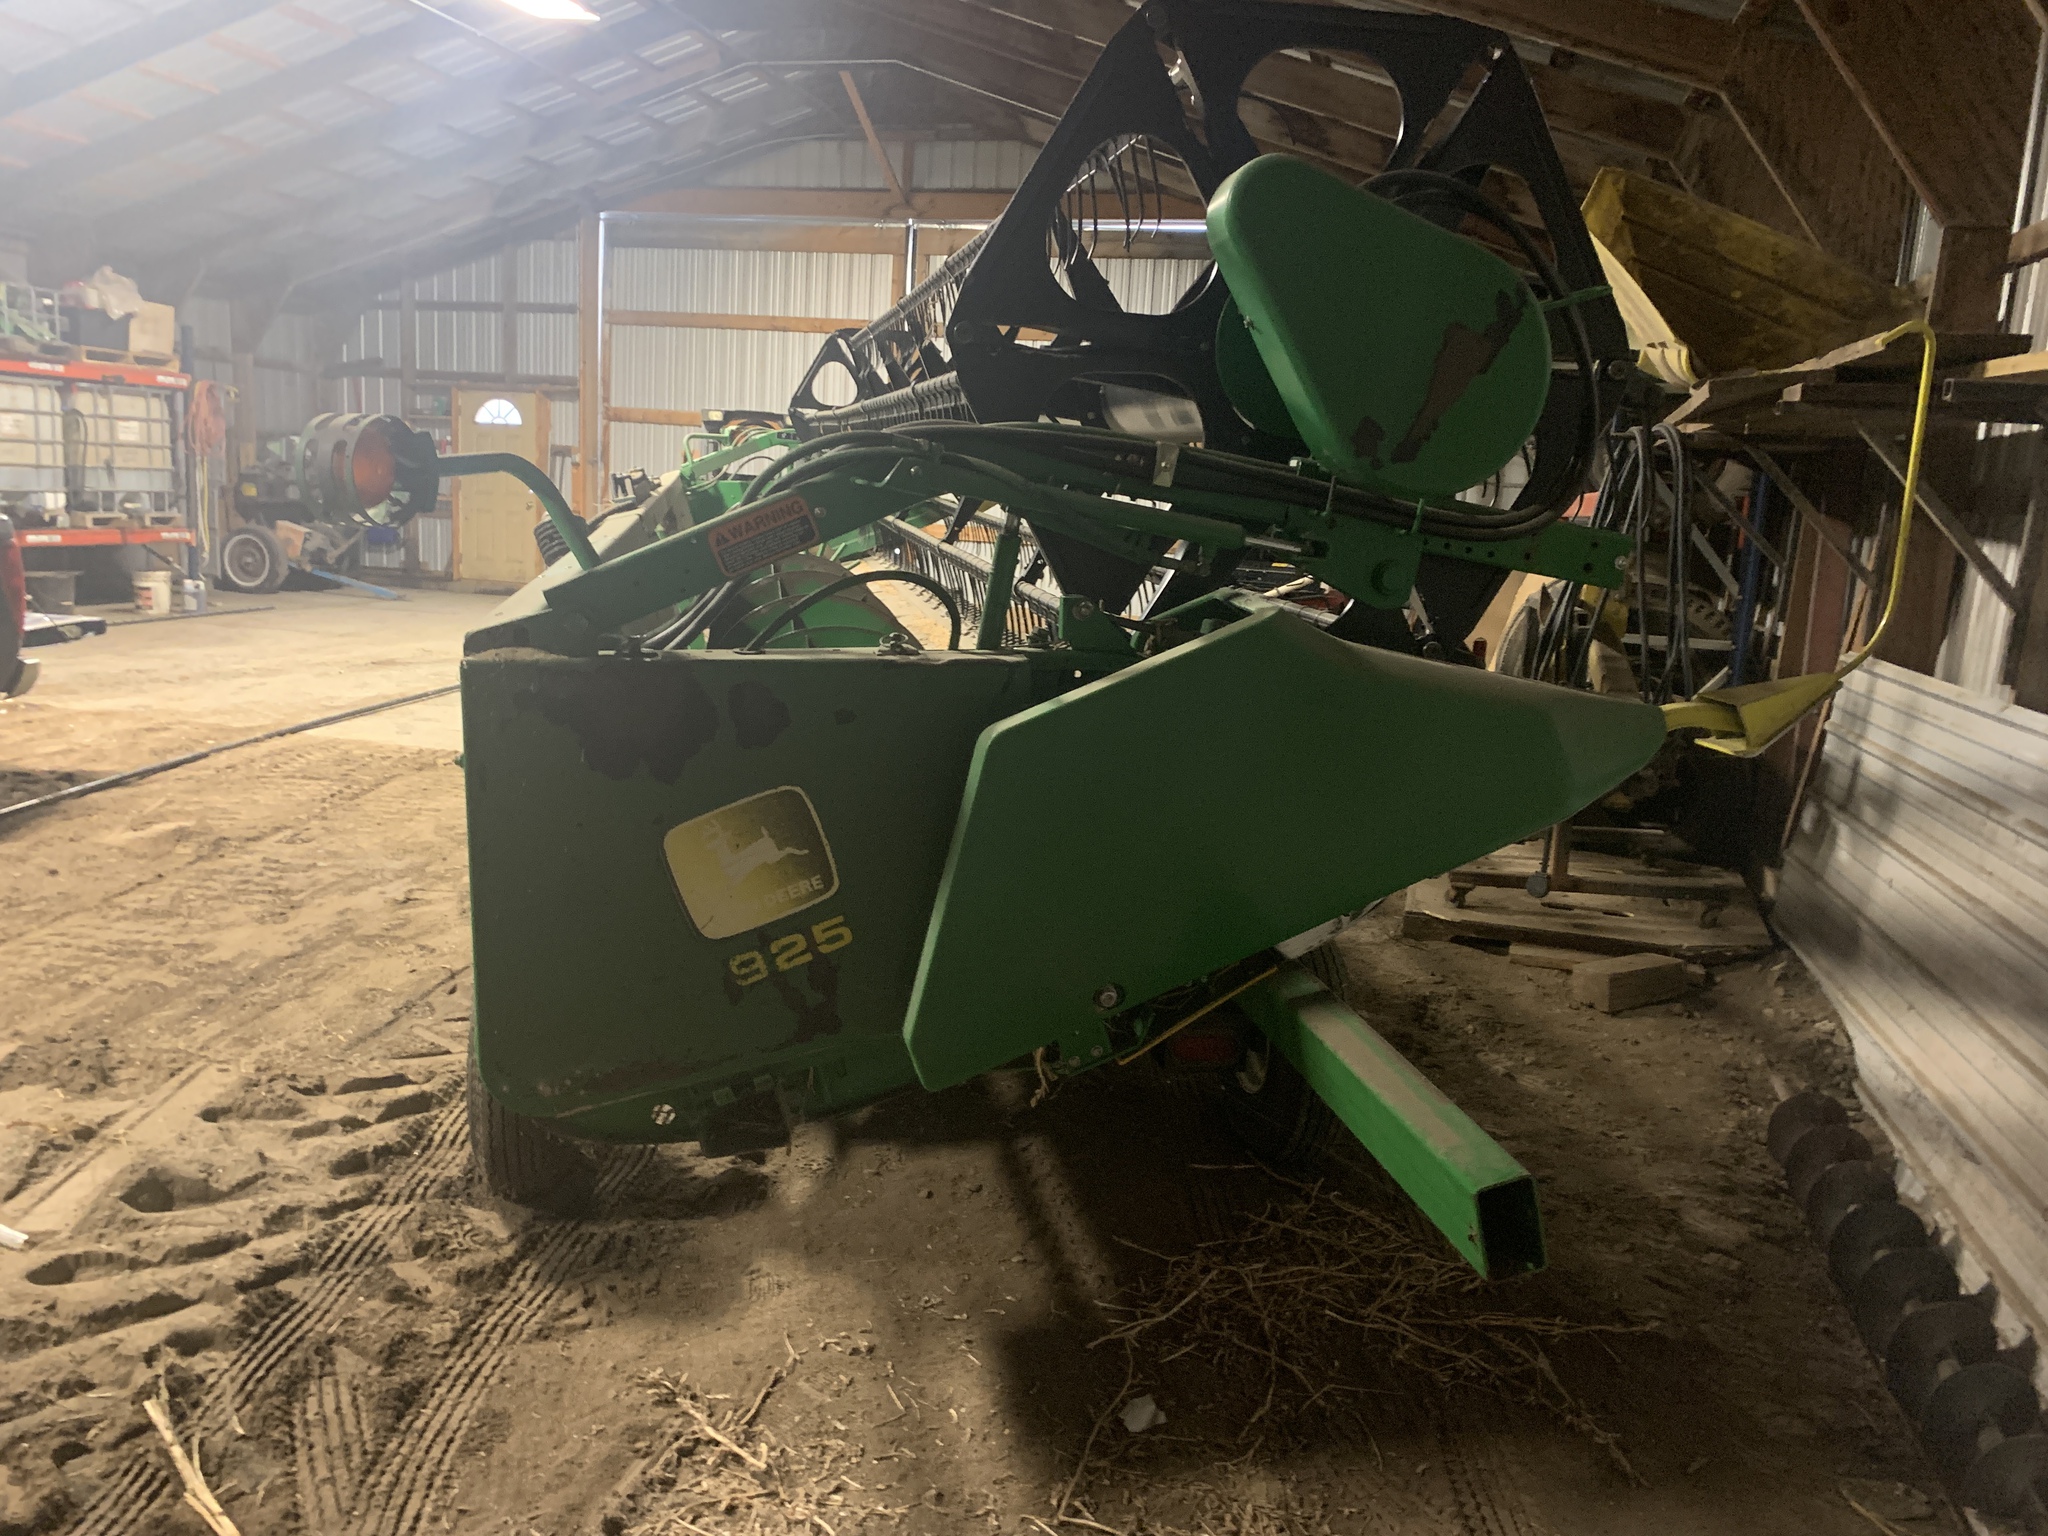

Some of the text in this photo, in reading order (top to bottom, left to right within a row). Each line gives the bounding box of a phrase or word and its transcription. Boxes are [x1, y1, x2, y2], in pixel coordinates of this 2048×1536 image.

[728, 500, 803, 538] WARNING
[764, 875, 825, 906] DEERE
[729, 915, 854, 987] 925
